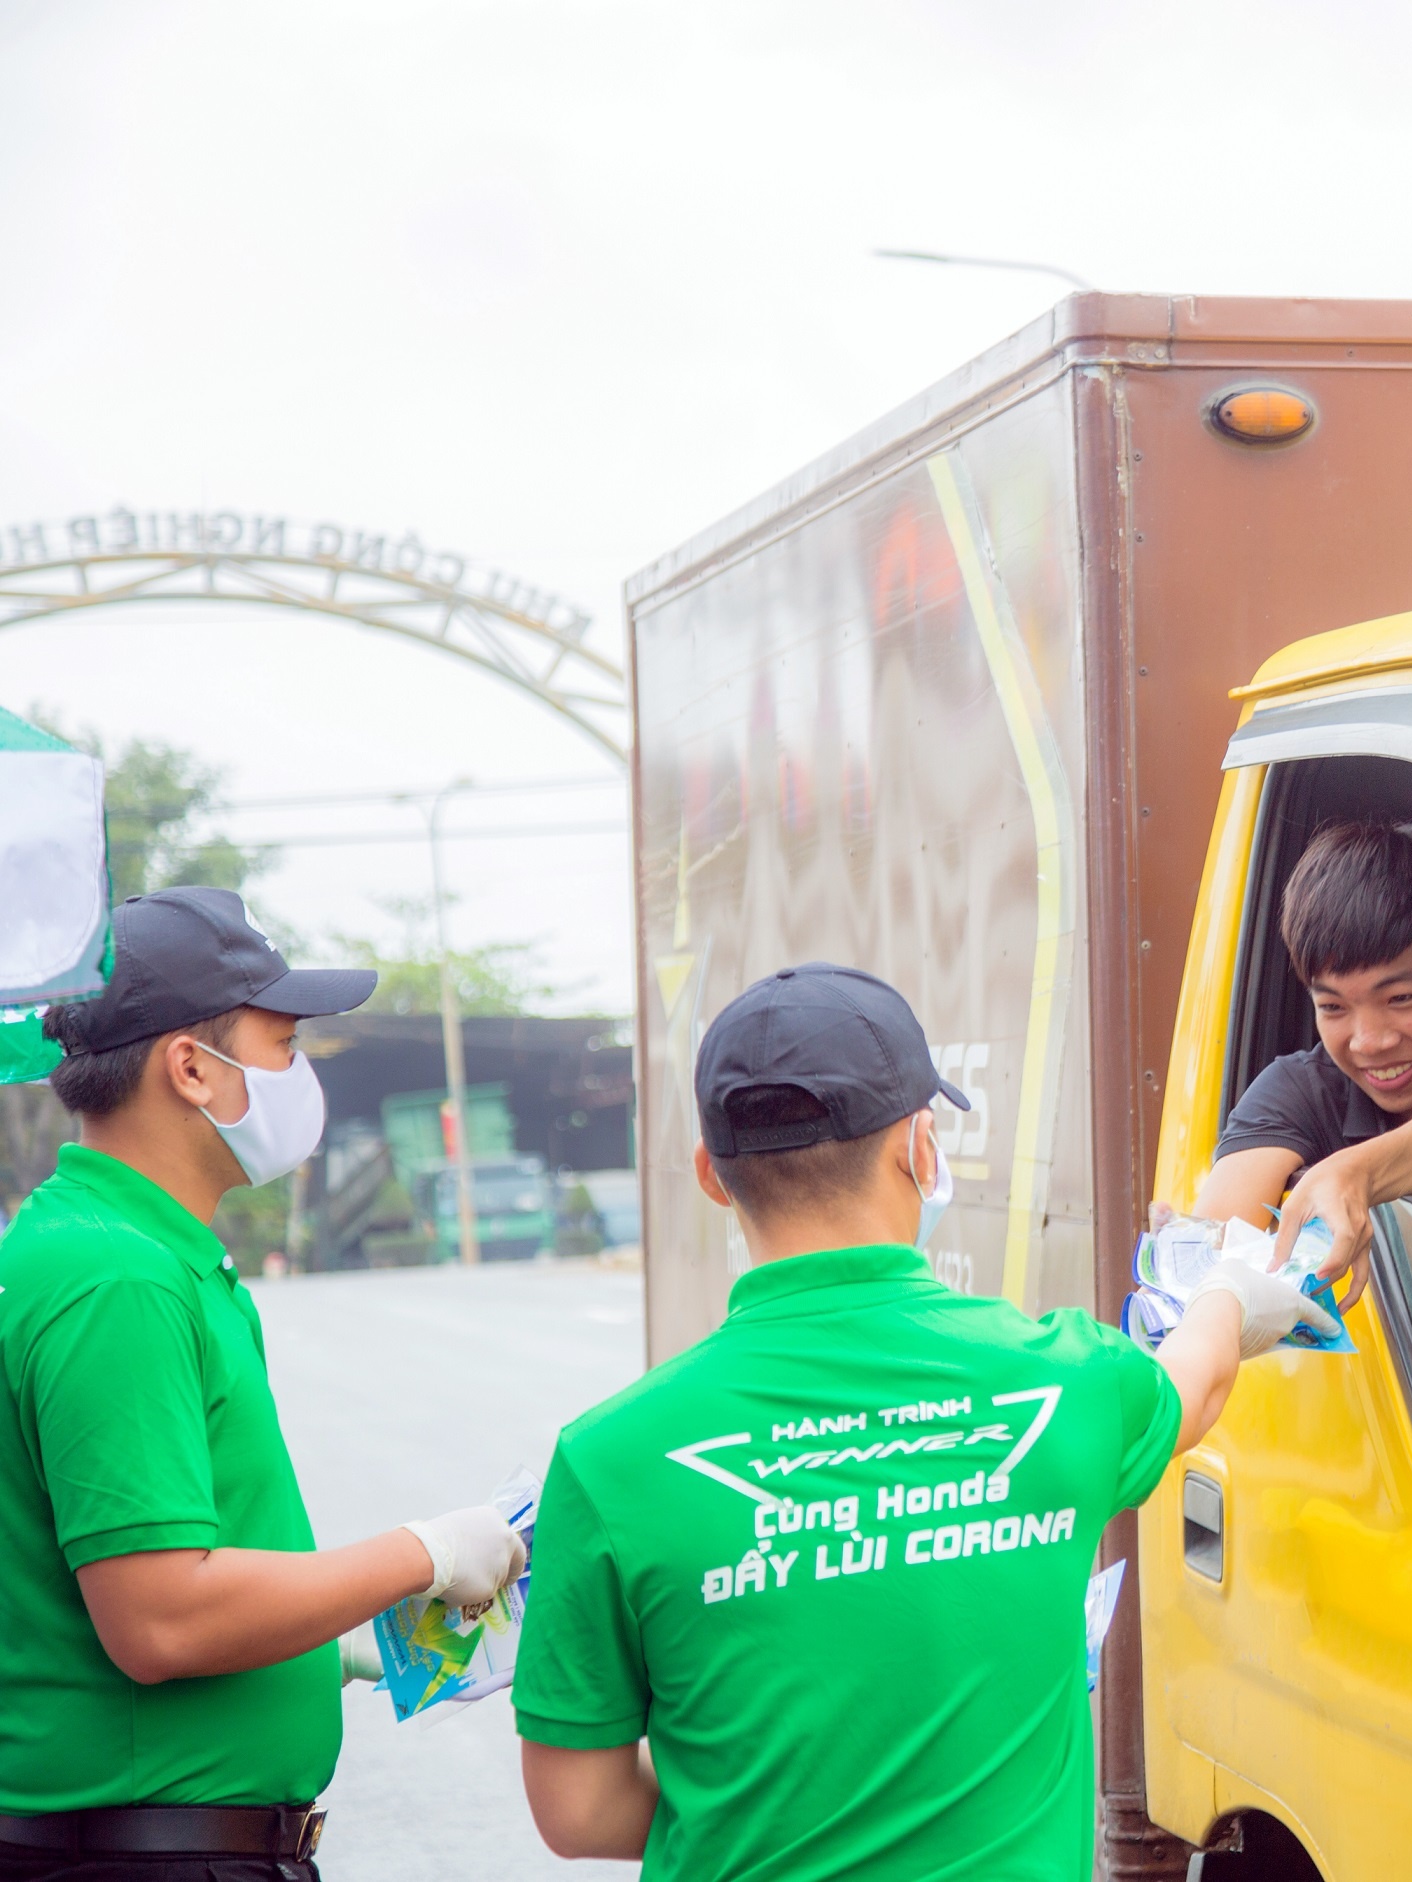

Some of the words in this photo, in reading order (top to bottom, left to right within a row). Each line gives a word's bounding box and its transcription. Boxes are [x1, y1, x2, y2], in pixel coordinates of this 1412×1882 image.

[771, 1412, 867, 1441] HÀNH
[878, 1395, 972, 1426] TRÌNH
[747, 1423, 1014, 1479] WINNER
[754, 1496, 859, 1539] Cùng
[876, 1471, 1010, 1520] Honda
[701, 1539, 799, 1605] ĐẨY
[814, 1530, 888, 1580] LÙI
[904, 1507, 1076, 1565] CORONA
